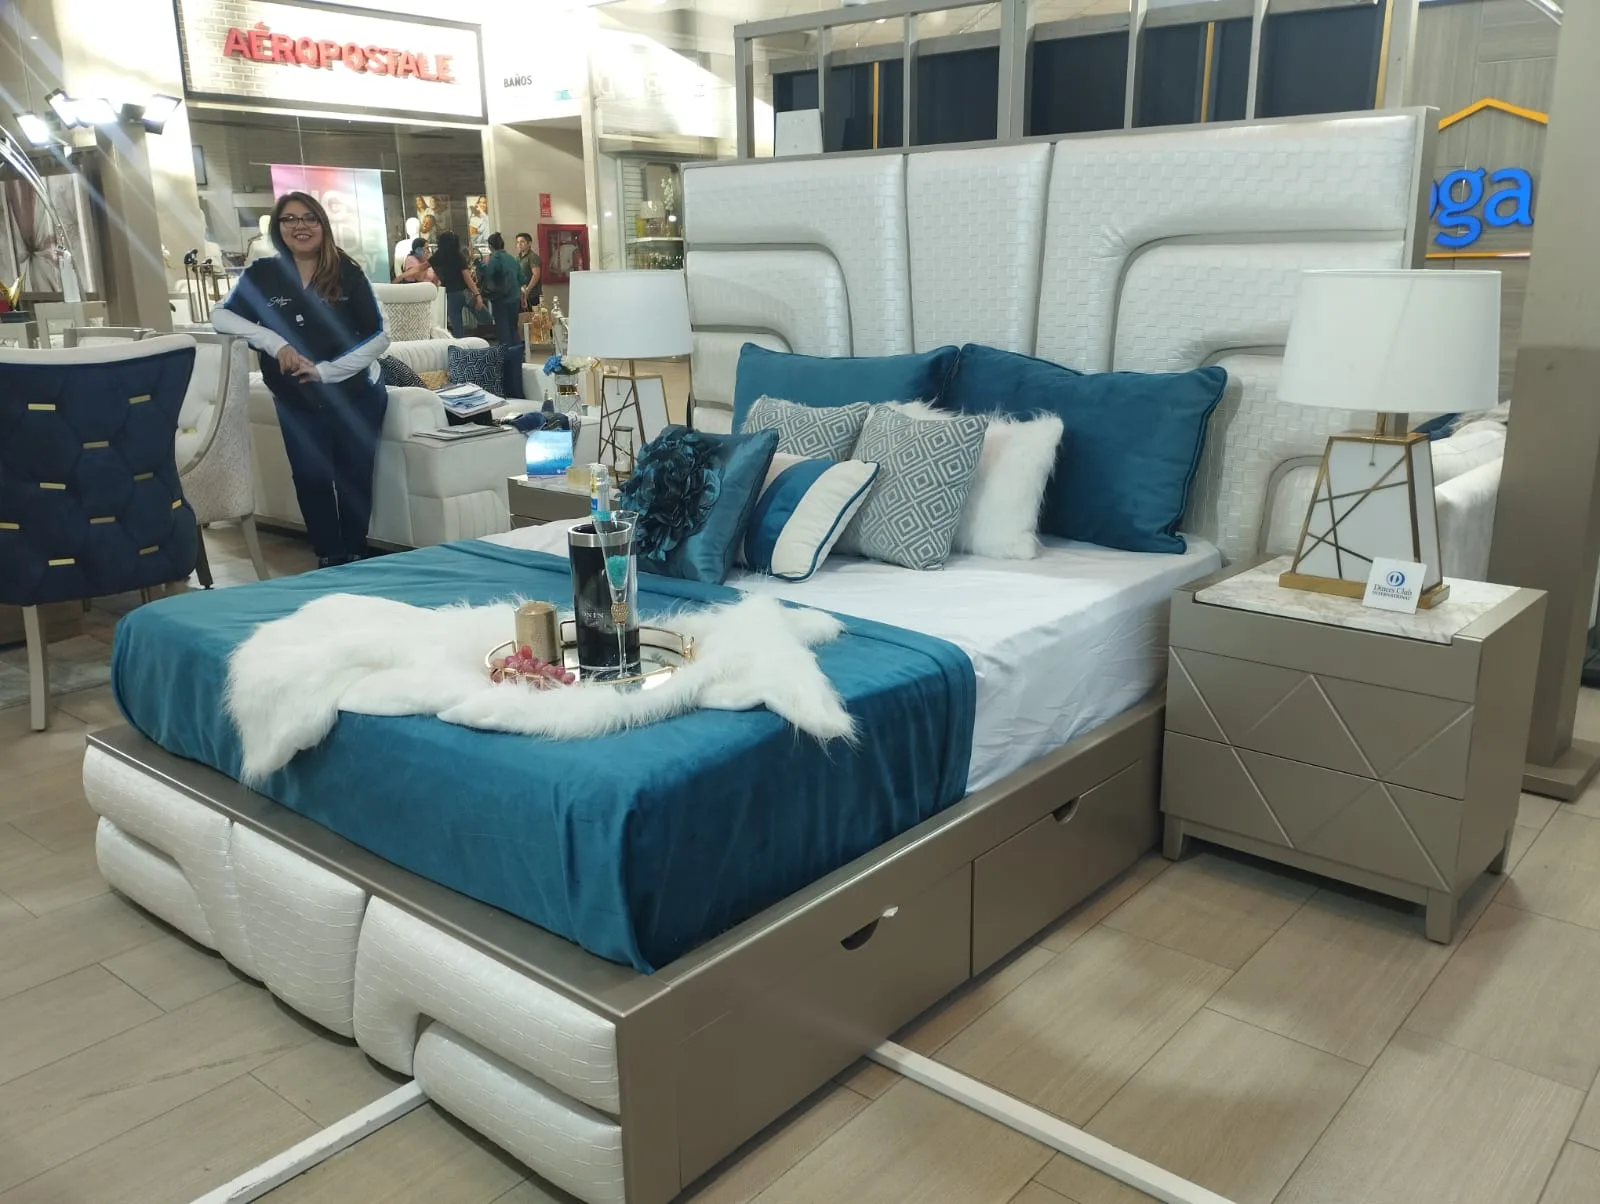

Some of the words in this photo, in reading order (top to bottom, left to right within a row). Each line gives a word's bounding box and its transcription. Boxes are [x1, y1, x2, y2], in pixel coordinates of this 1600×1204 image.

[223, 22, 455, 83] AÉROPOSTALE
[503, 73, 533, 88] BAÑOS
[1428, 167, 1535, 249] ga
